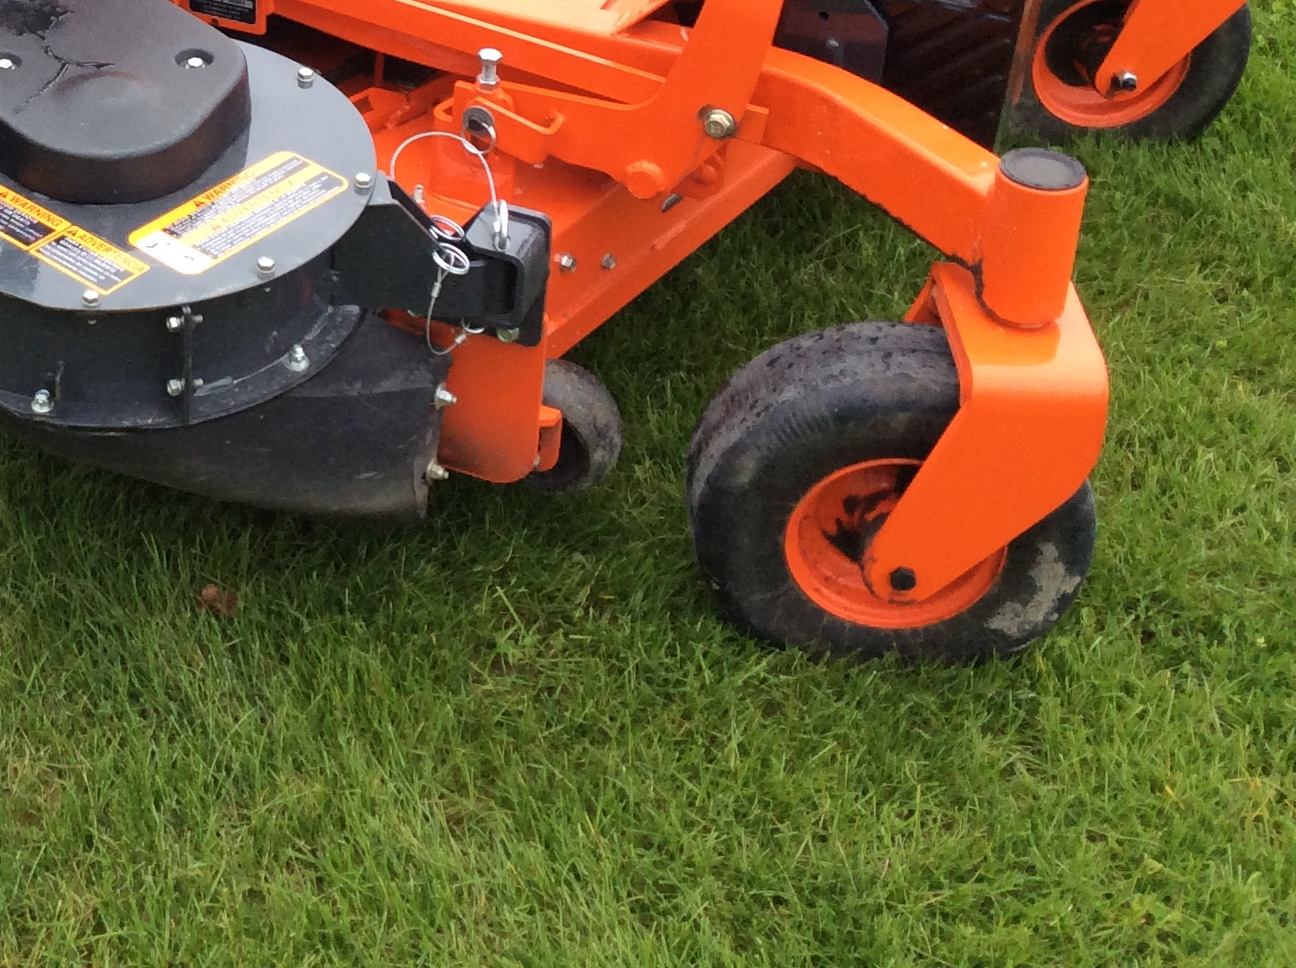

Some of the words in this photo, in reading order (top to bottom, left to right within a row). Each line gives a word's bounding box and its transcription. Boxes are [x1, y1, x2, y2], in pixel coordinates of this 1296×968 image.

[203, 171, 256, 203] WARNING
[9, 193, 64, 228] WARNING
[78, 231, 146, 274] ADVERTENCIA
